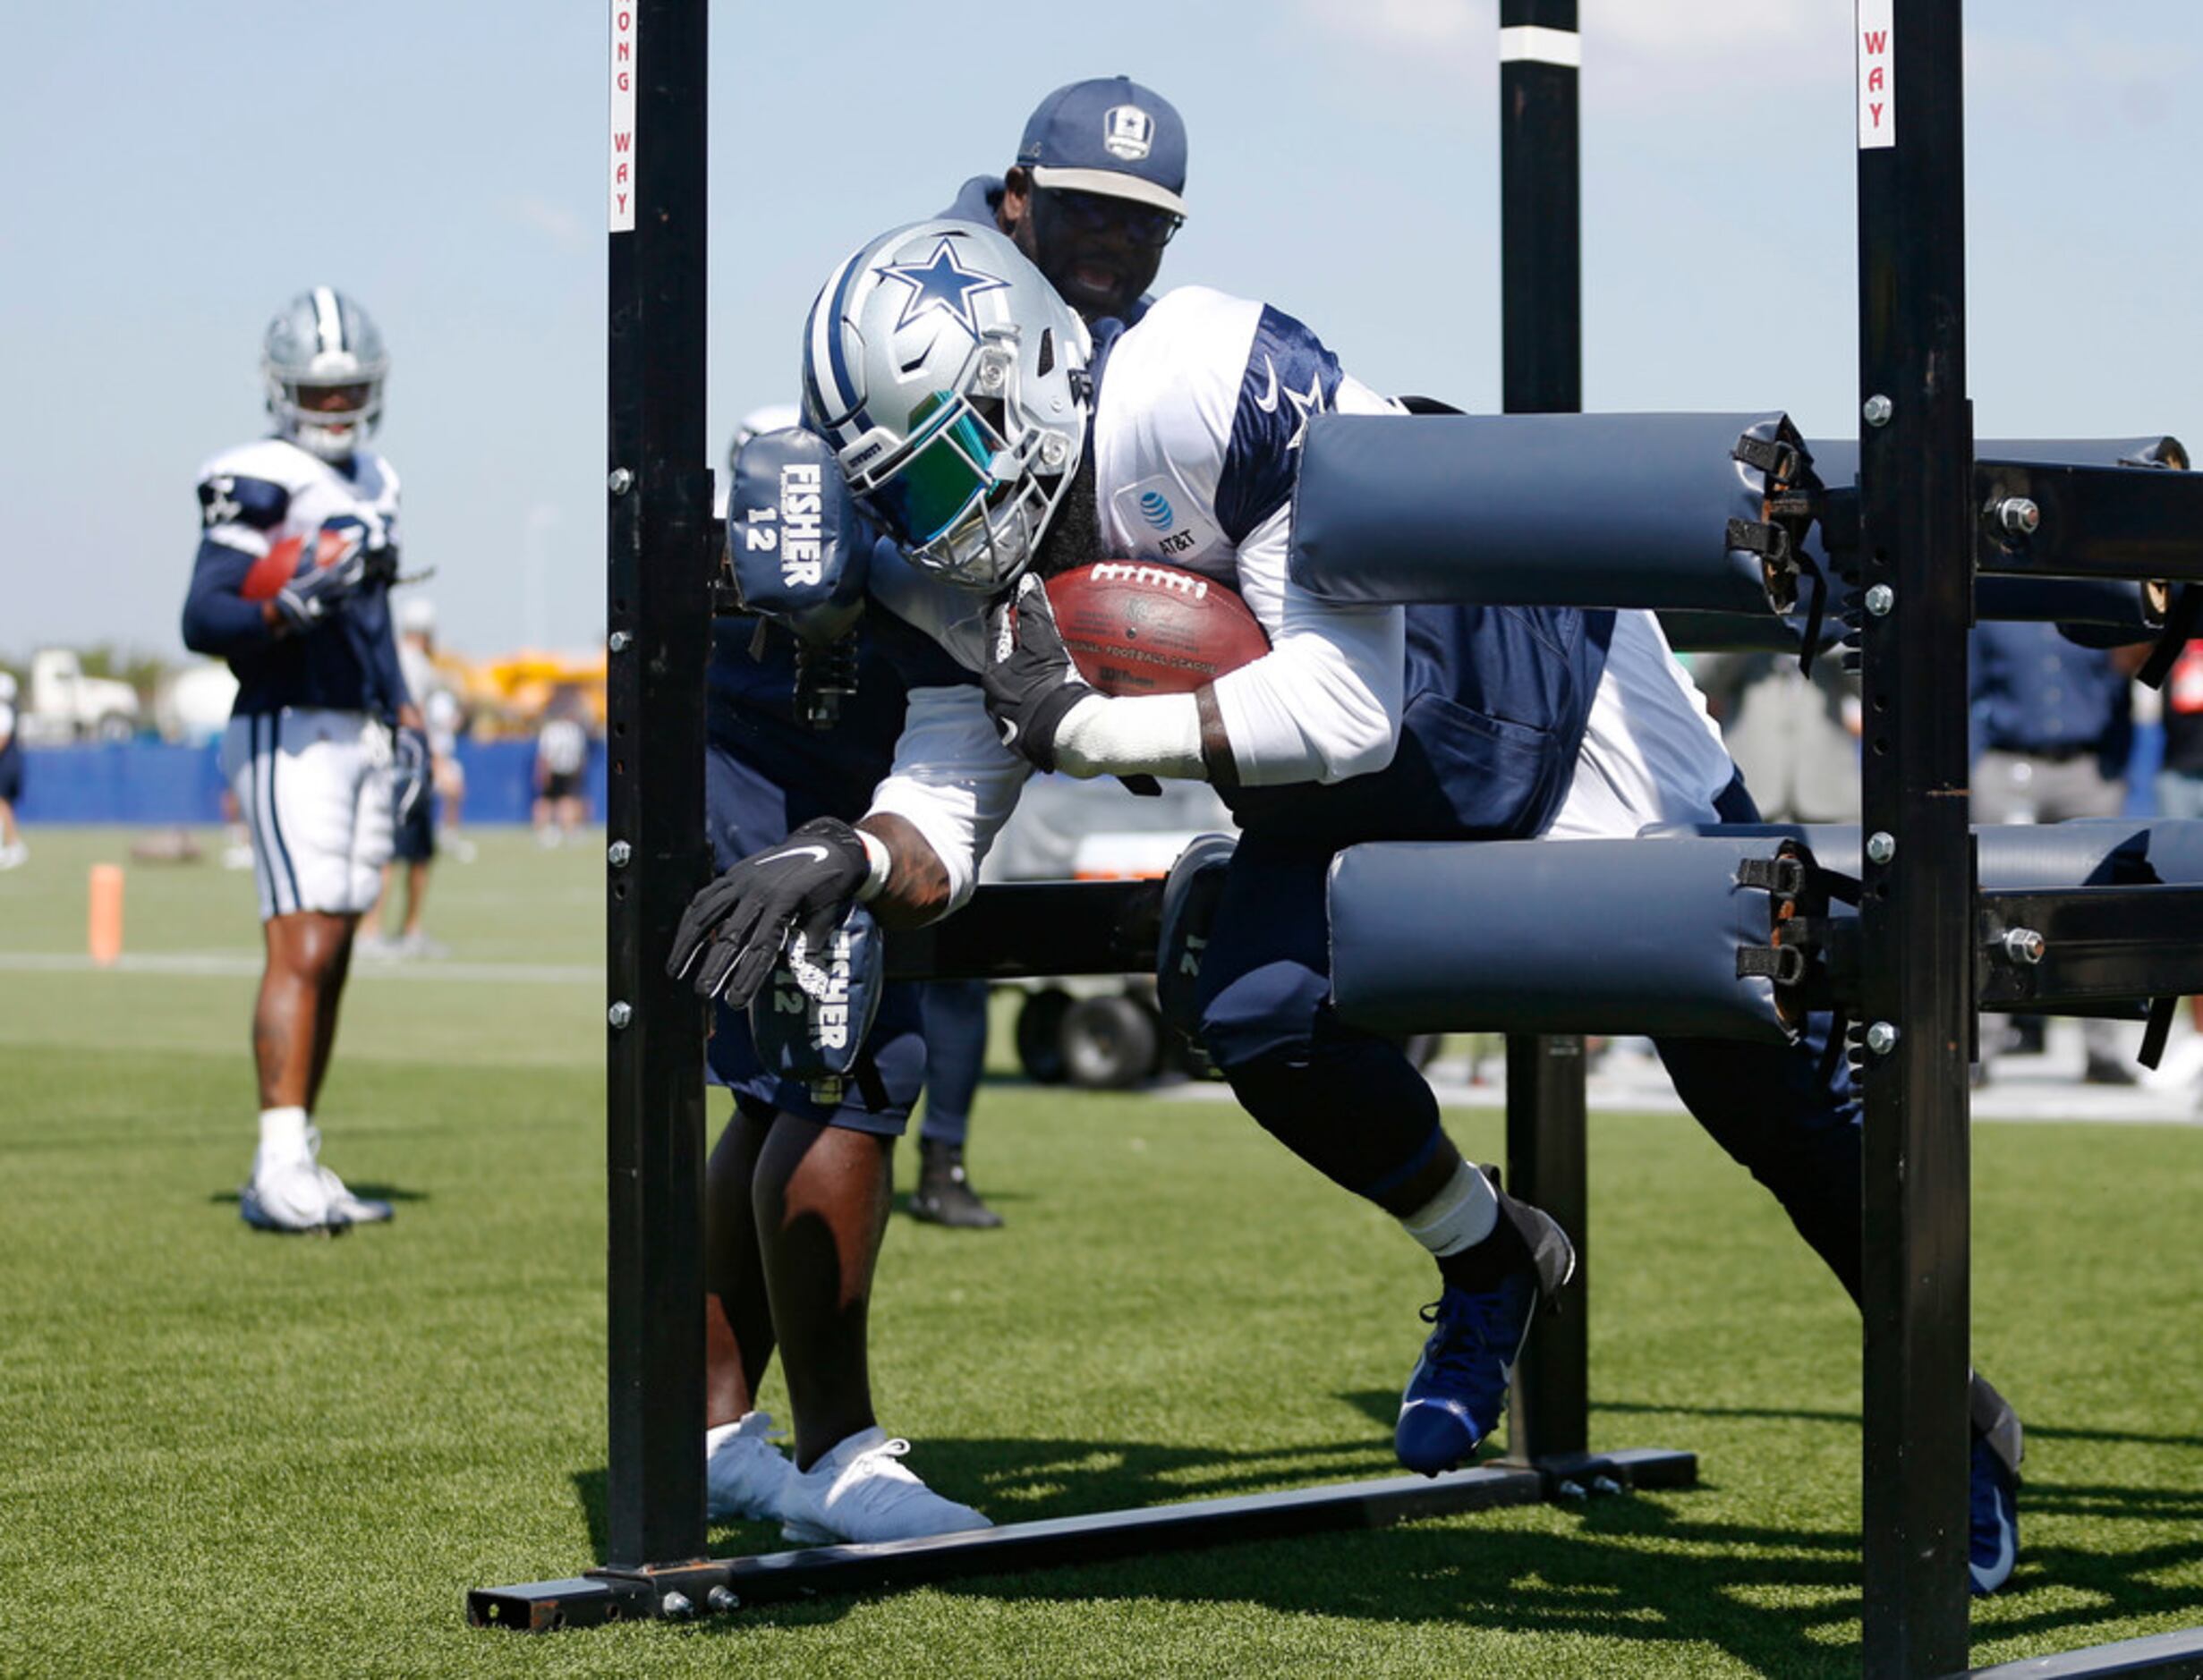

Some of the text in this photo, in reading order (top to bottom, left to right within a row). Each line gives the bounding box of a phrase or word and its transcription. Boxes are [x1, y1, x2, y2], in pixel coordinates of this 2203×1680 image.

[615, 0, 631, 215] ONG WAY
[1864, 30, 1887, 130] WAY
[746, 508, 777, 551] 12
[780, 464, 822, 588] FISHER
[1159, 529, 1195, 555] AT&T
